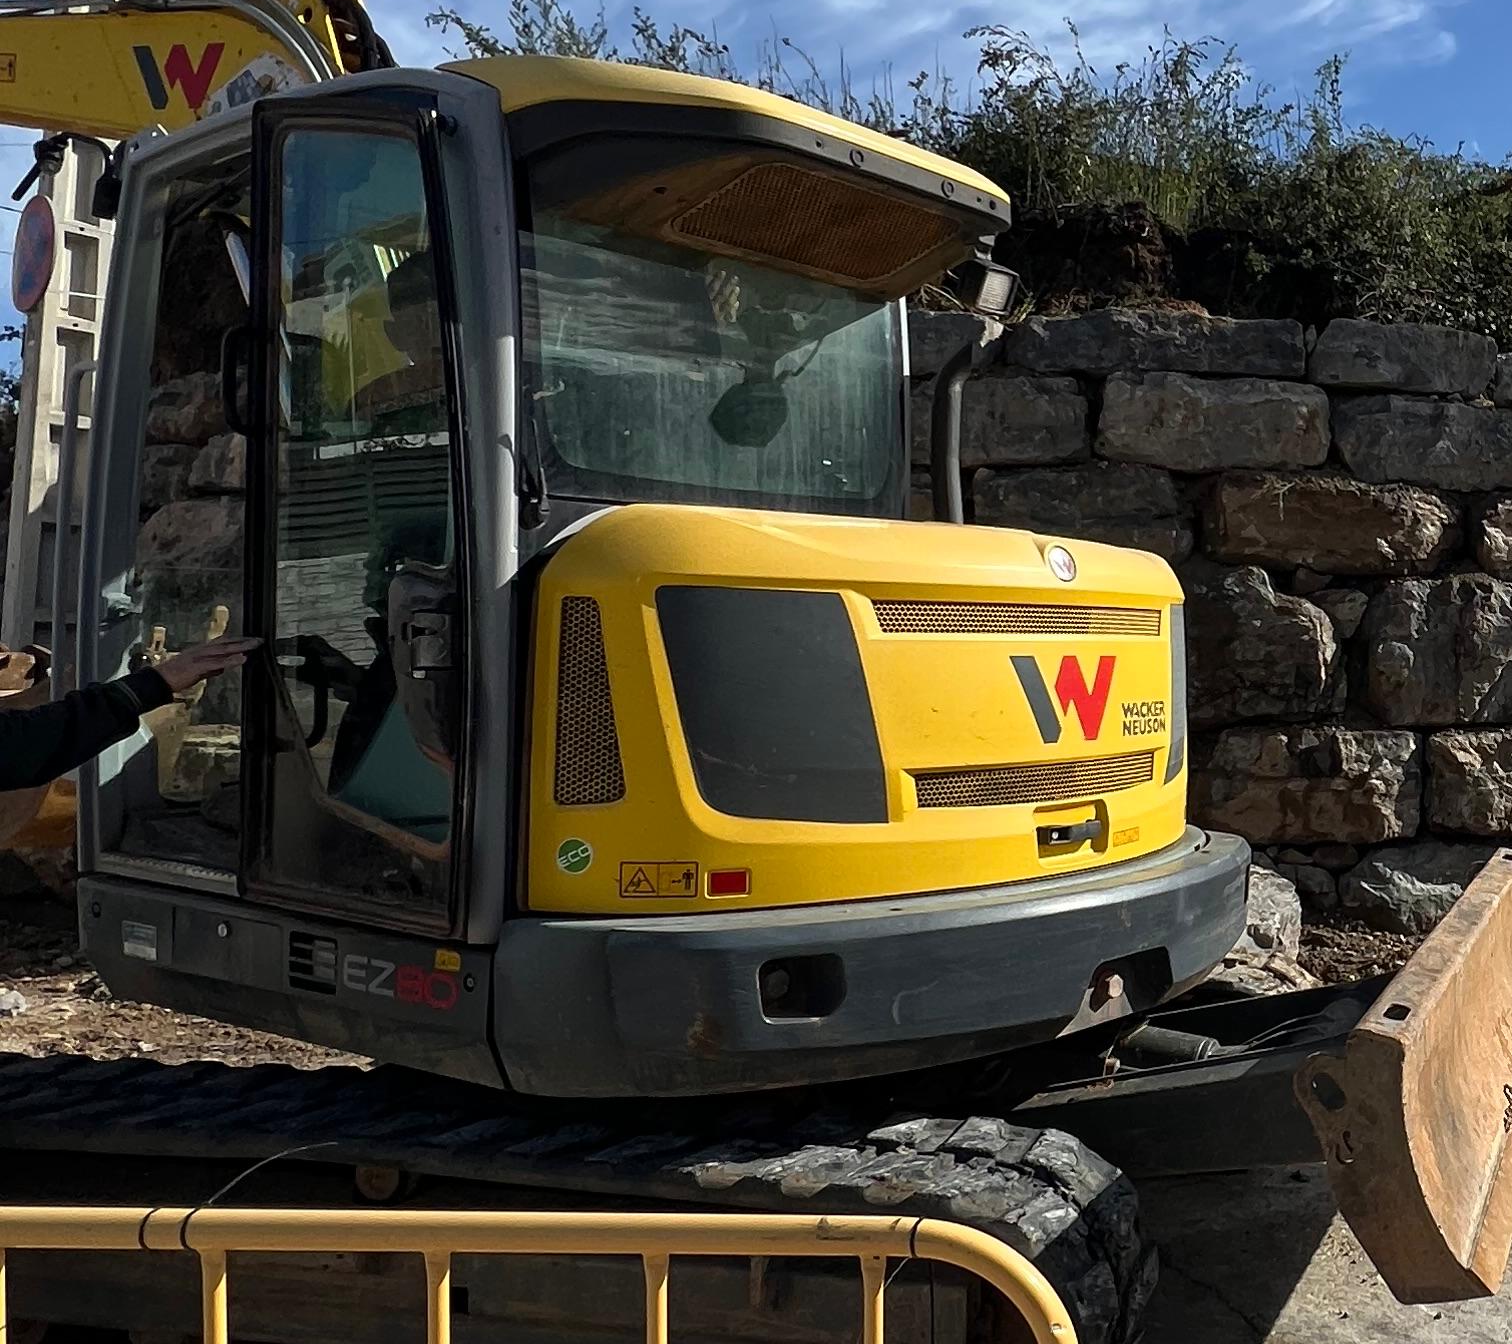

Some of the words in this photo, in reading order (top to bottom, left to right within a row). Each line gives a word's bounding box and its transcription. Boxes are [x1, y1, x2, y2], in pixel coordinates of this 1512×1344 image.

[132, 42, 225, 110] W
[1009, 655, 1117, 744] W
[1121, 700, 1166, 719] WACKER
[1122, 717, 1166, 737] NEUSON
[558, 843, 592, 869] ECO
[343, 954, 458, 1010] EZ80
